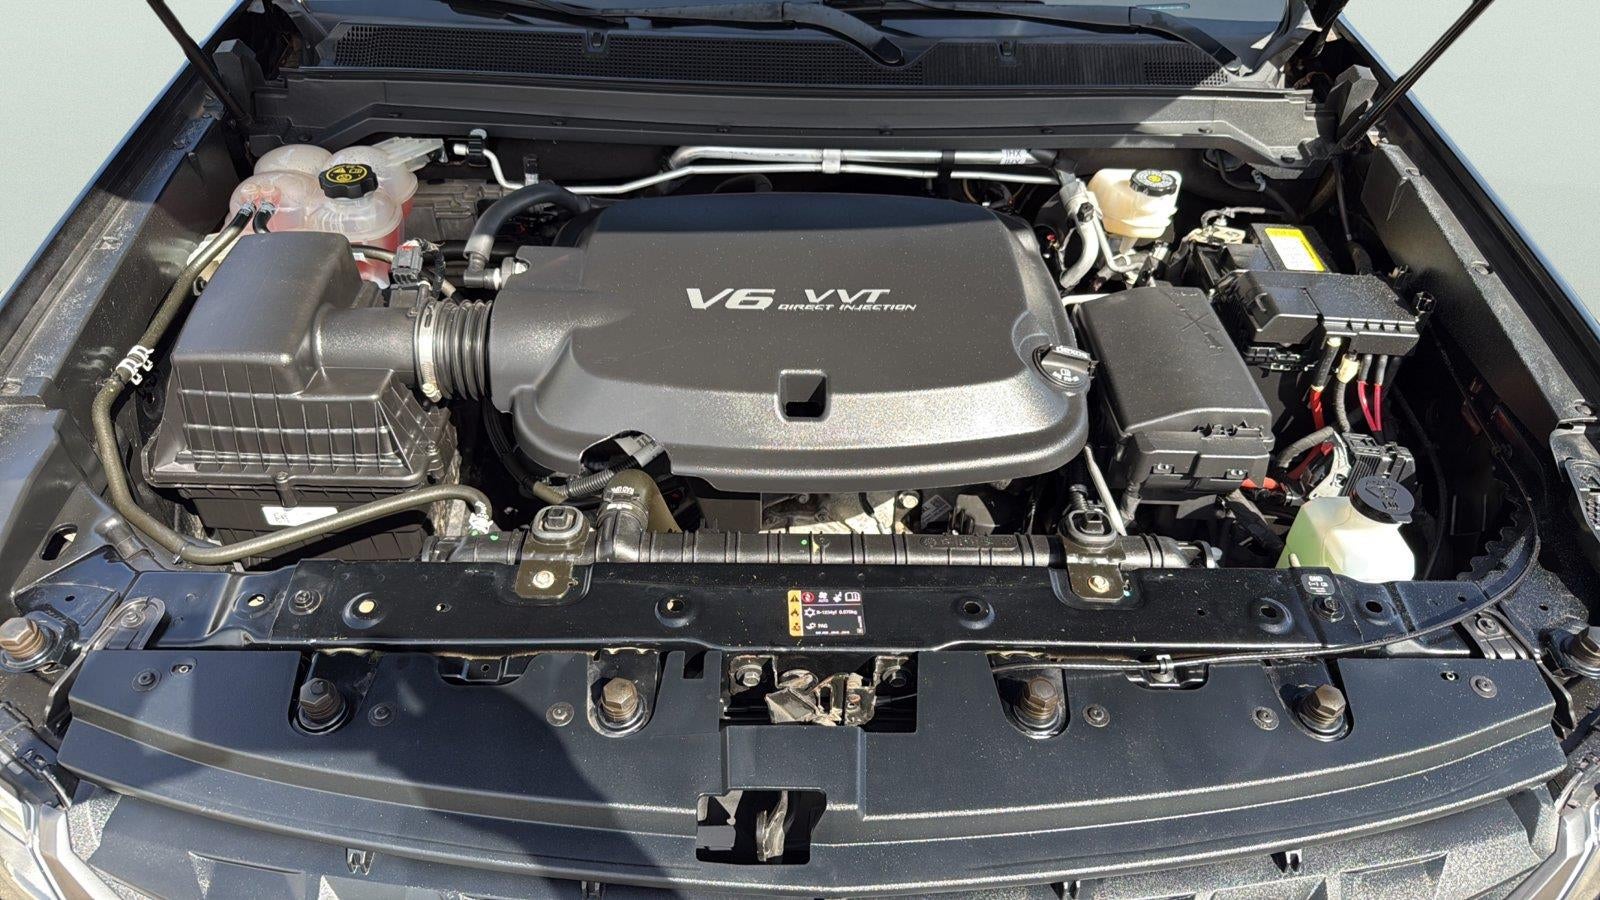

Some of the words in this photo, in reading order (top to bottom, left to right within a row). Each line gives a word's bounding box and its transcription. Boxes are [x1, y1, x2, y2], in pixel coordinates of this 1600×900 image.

[686, 287, 776, 310] V6
[804, 288, 891, 304] VVT
[839, 304, 917, 312] INJECTION
